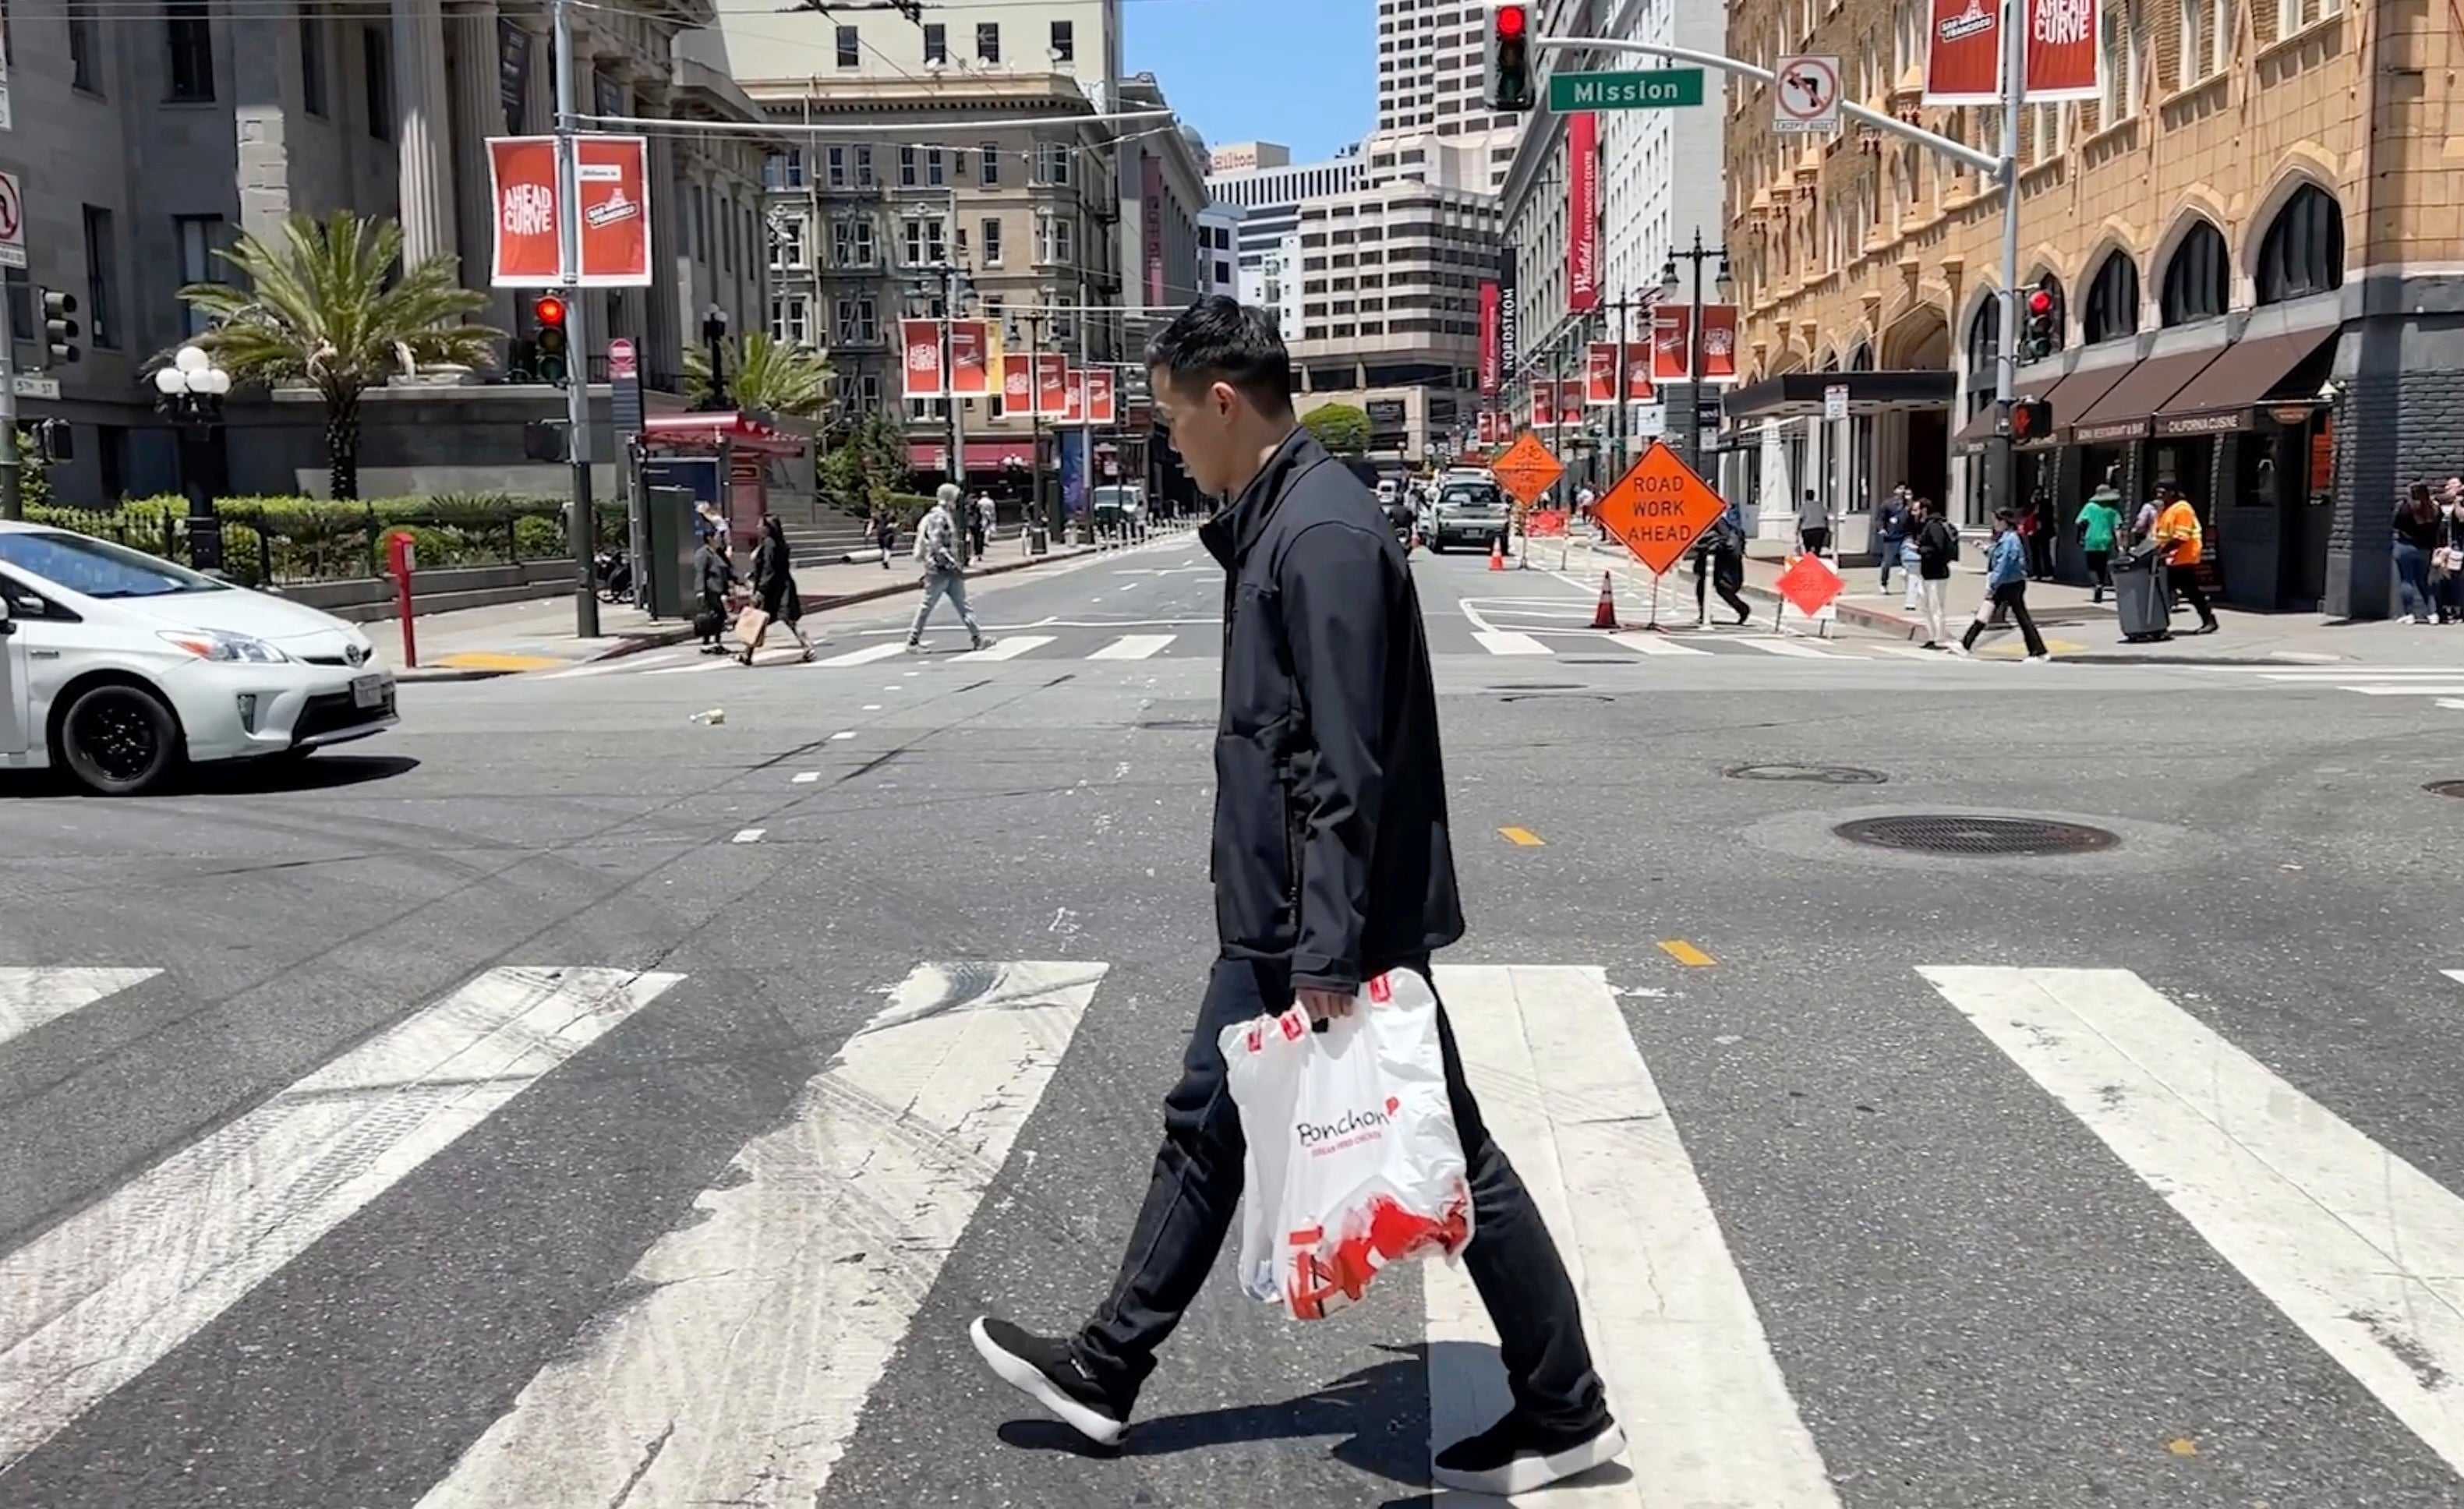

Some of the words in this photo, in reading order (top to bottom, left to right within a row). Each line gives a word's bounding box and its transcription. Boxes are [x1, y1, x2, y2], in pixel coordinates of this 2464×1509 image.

[2034, 0, 2091, 19] AHEAD
[2034, 15, 2091, 44] CURVE
[1574, 80, 1678, 103] Mission
[1213, 151, 1256, 171] Hilton
[504, 183, 553, 210] AHEAD
[504, 207, 553, 236] CURVE
[1501, 288, 1515, 370] NORDSTROM
[1633, 475, 1684, 493] ROAD
[1633, 500, 1684, 518] WORK
[1628, 525, 1692, 542] AHEAD
